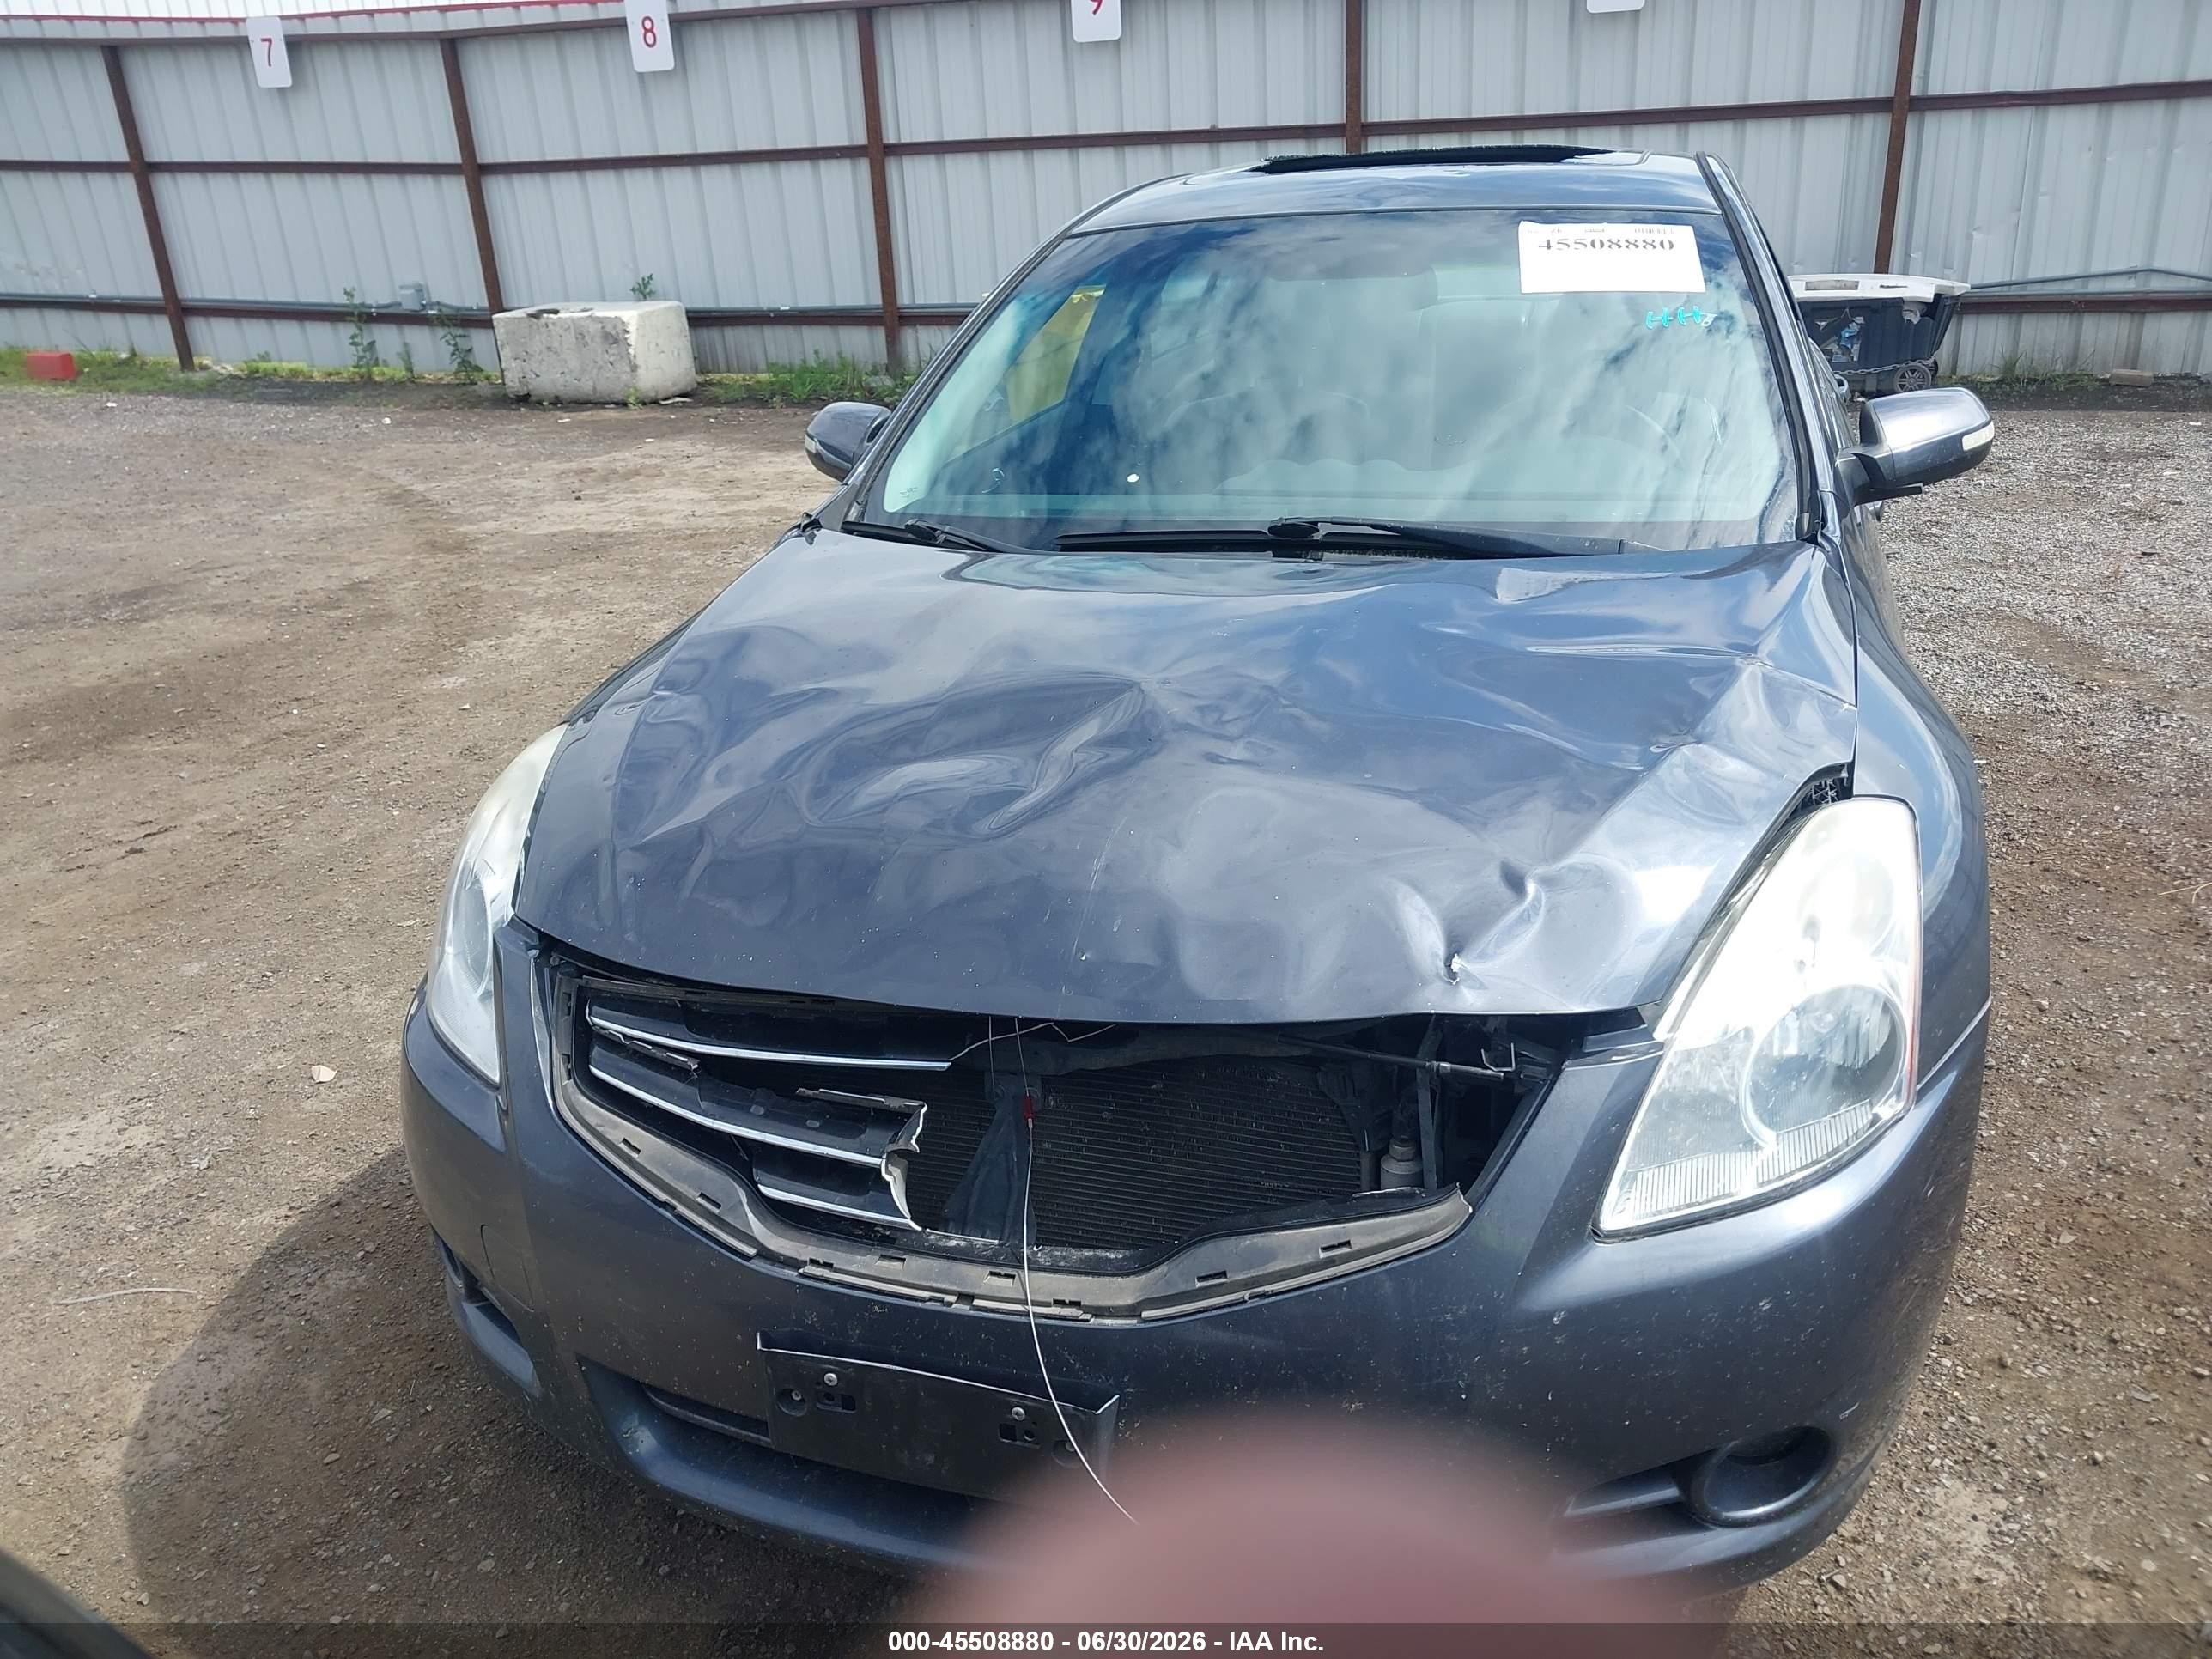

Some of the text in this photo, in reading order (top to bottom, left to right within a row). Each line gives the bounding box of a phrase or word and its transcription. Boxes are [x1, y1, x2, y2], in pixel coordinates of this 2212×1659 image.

[641, 15, 657, 48] 8
[260, 38, 273, 67] 7
[1537, 238, 1674, 251] 45508880
